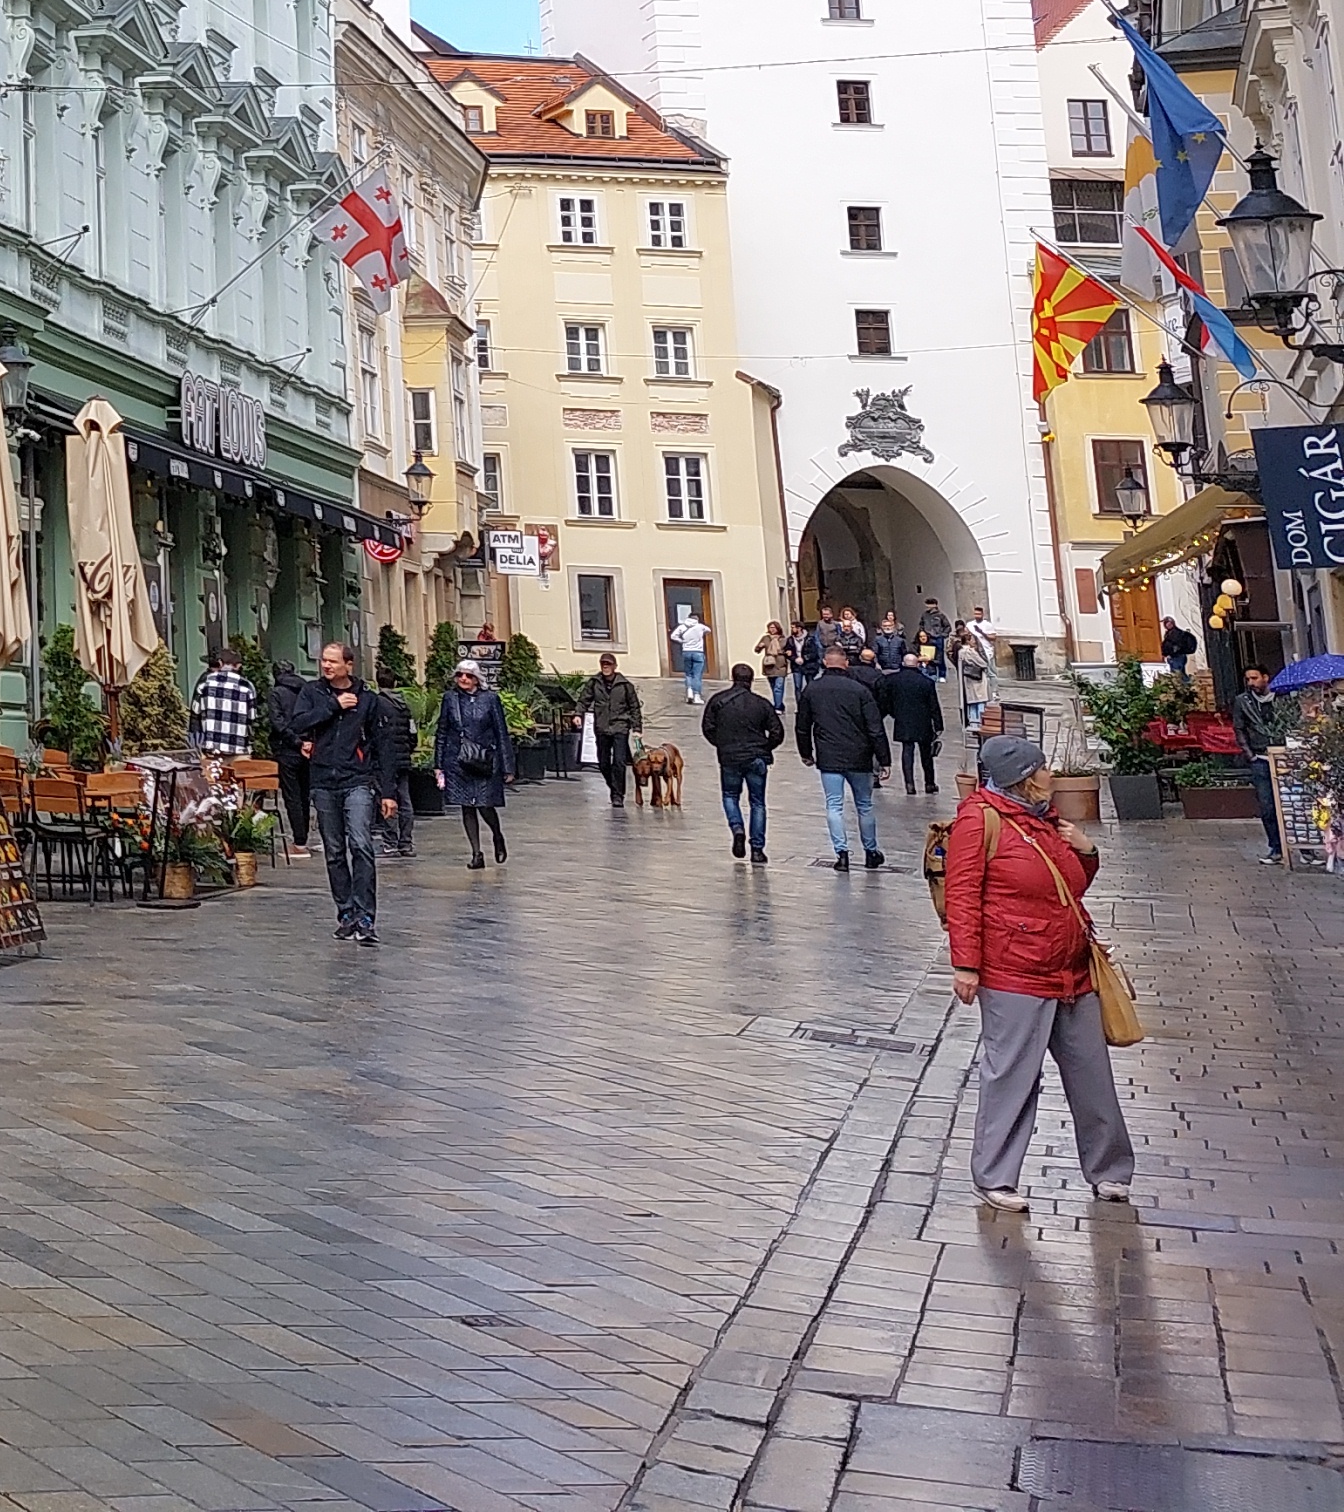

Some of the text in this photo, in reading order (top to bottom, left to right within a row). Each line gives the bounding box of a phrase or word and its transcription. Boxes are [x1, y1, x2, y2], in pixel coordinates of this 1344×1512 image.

[1297, 428, 1344, 564] CIGÁR
[492, 534, 519, 545] ATM
[1282, 509, 1312, 565] DOM
[499, 554, 536, 567] DELIA
